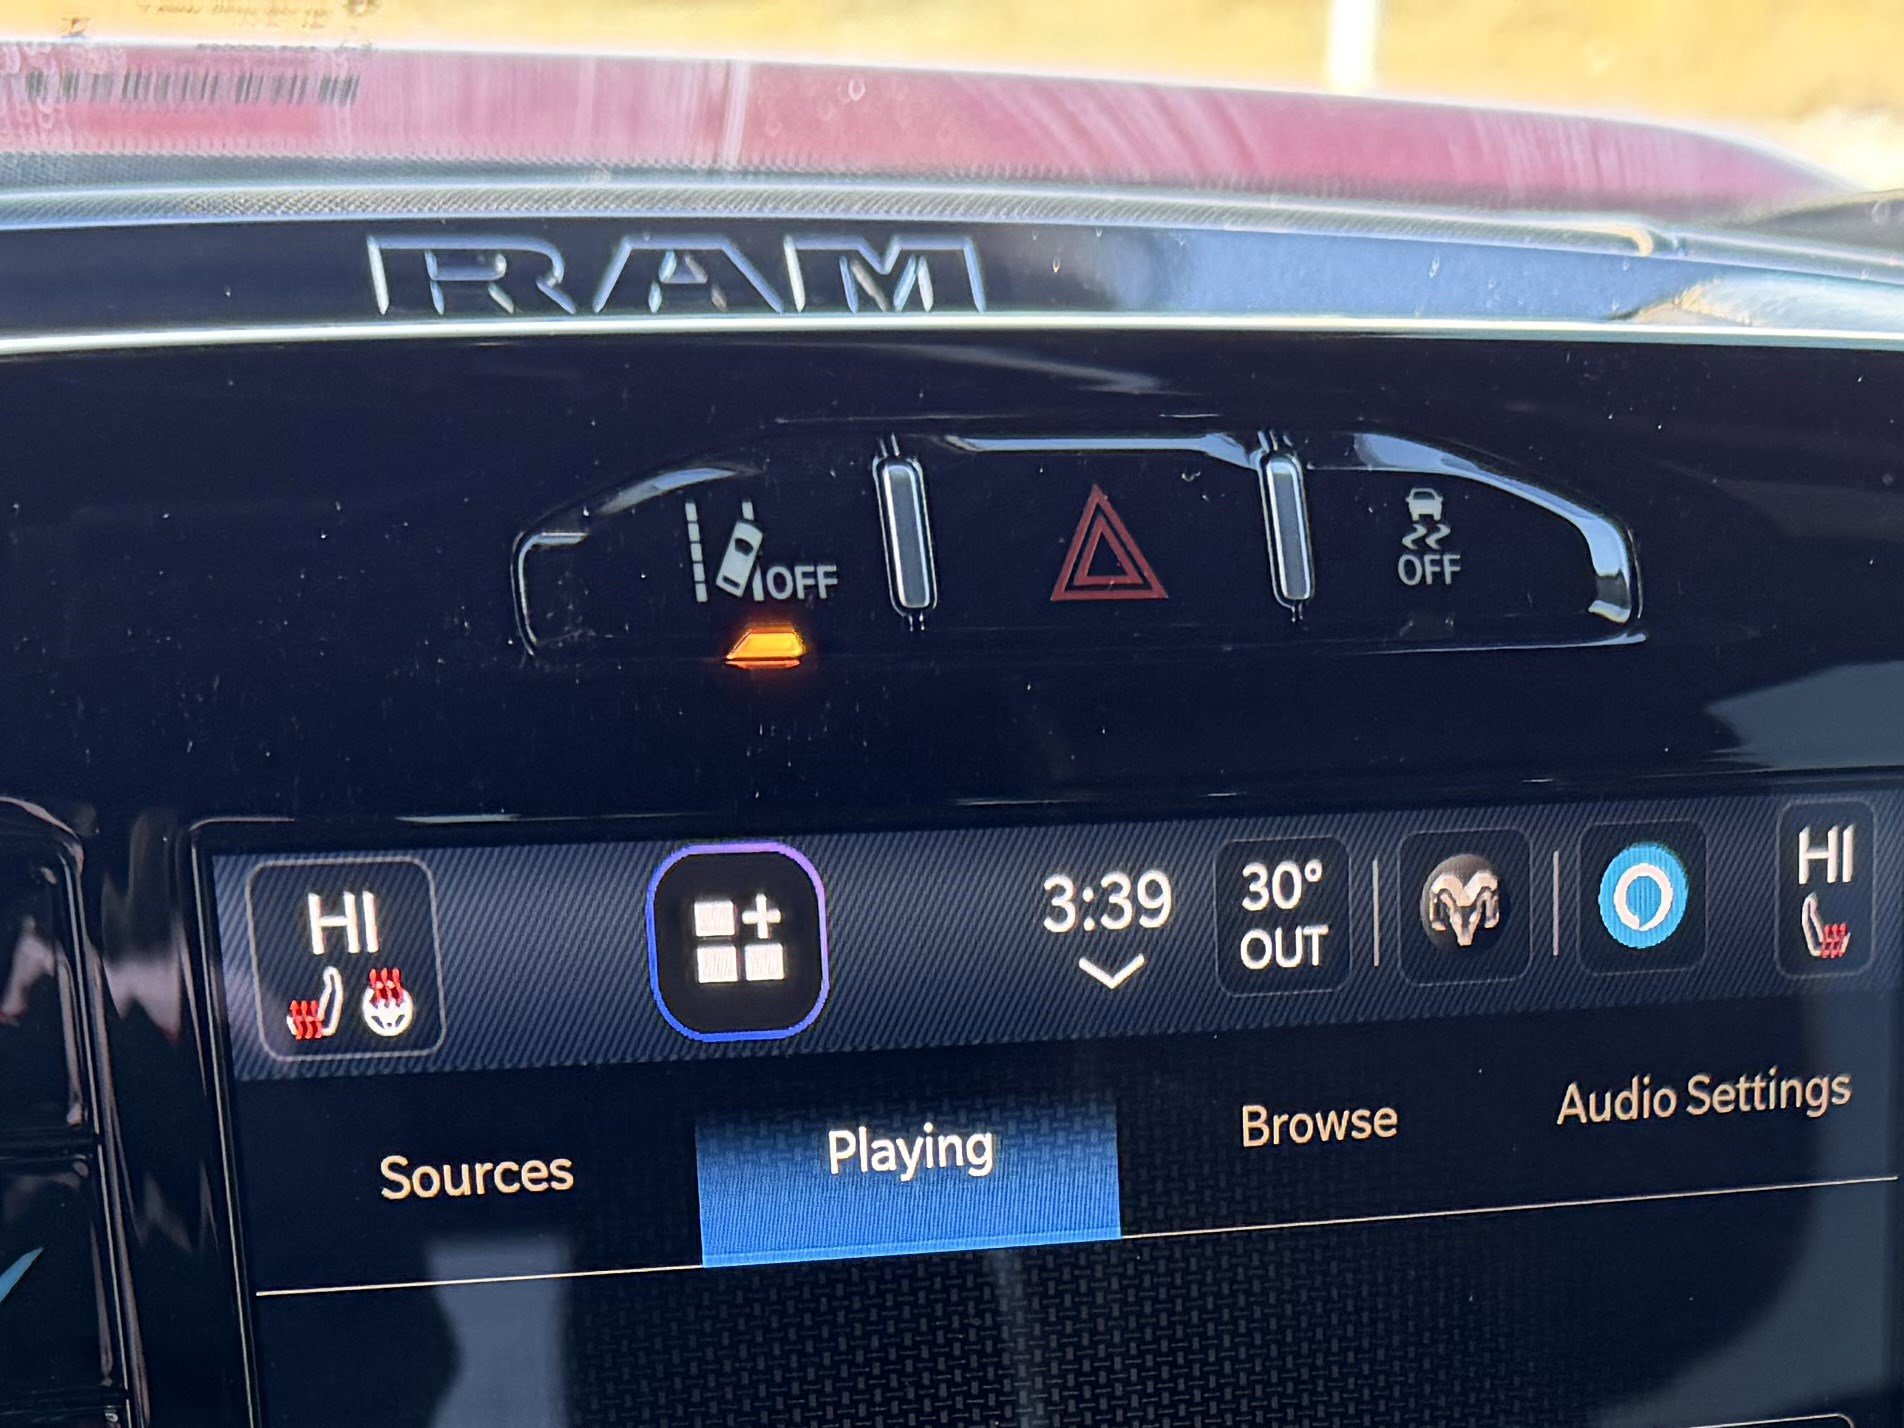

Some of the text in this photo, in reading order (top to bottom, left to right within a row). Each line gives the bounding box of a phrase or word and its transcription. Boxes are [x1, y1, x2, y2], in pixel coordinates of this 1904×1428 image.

[367, 234, 988, 315] RAM
[765, 566, 838, 600] OFF
[1397, 554, 1462, 586] OFF
[1798, 824, 1854, 886] HI
[1042, 867, 1173, 934] 3:39
[1240, 859, 1323, 913] 30°
[307, 891, 379, 955] HI
[1240, 925, 1329, 971] OUT
[1556, 1063, 1853, 1127] Audio Settings
[828, 1121, 996, 1183] Playing
[1241, 1103, 1398, 1148] Browse
[379, 1154, 575, 1202] Sources
